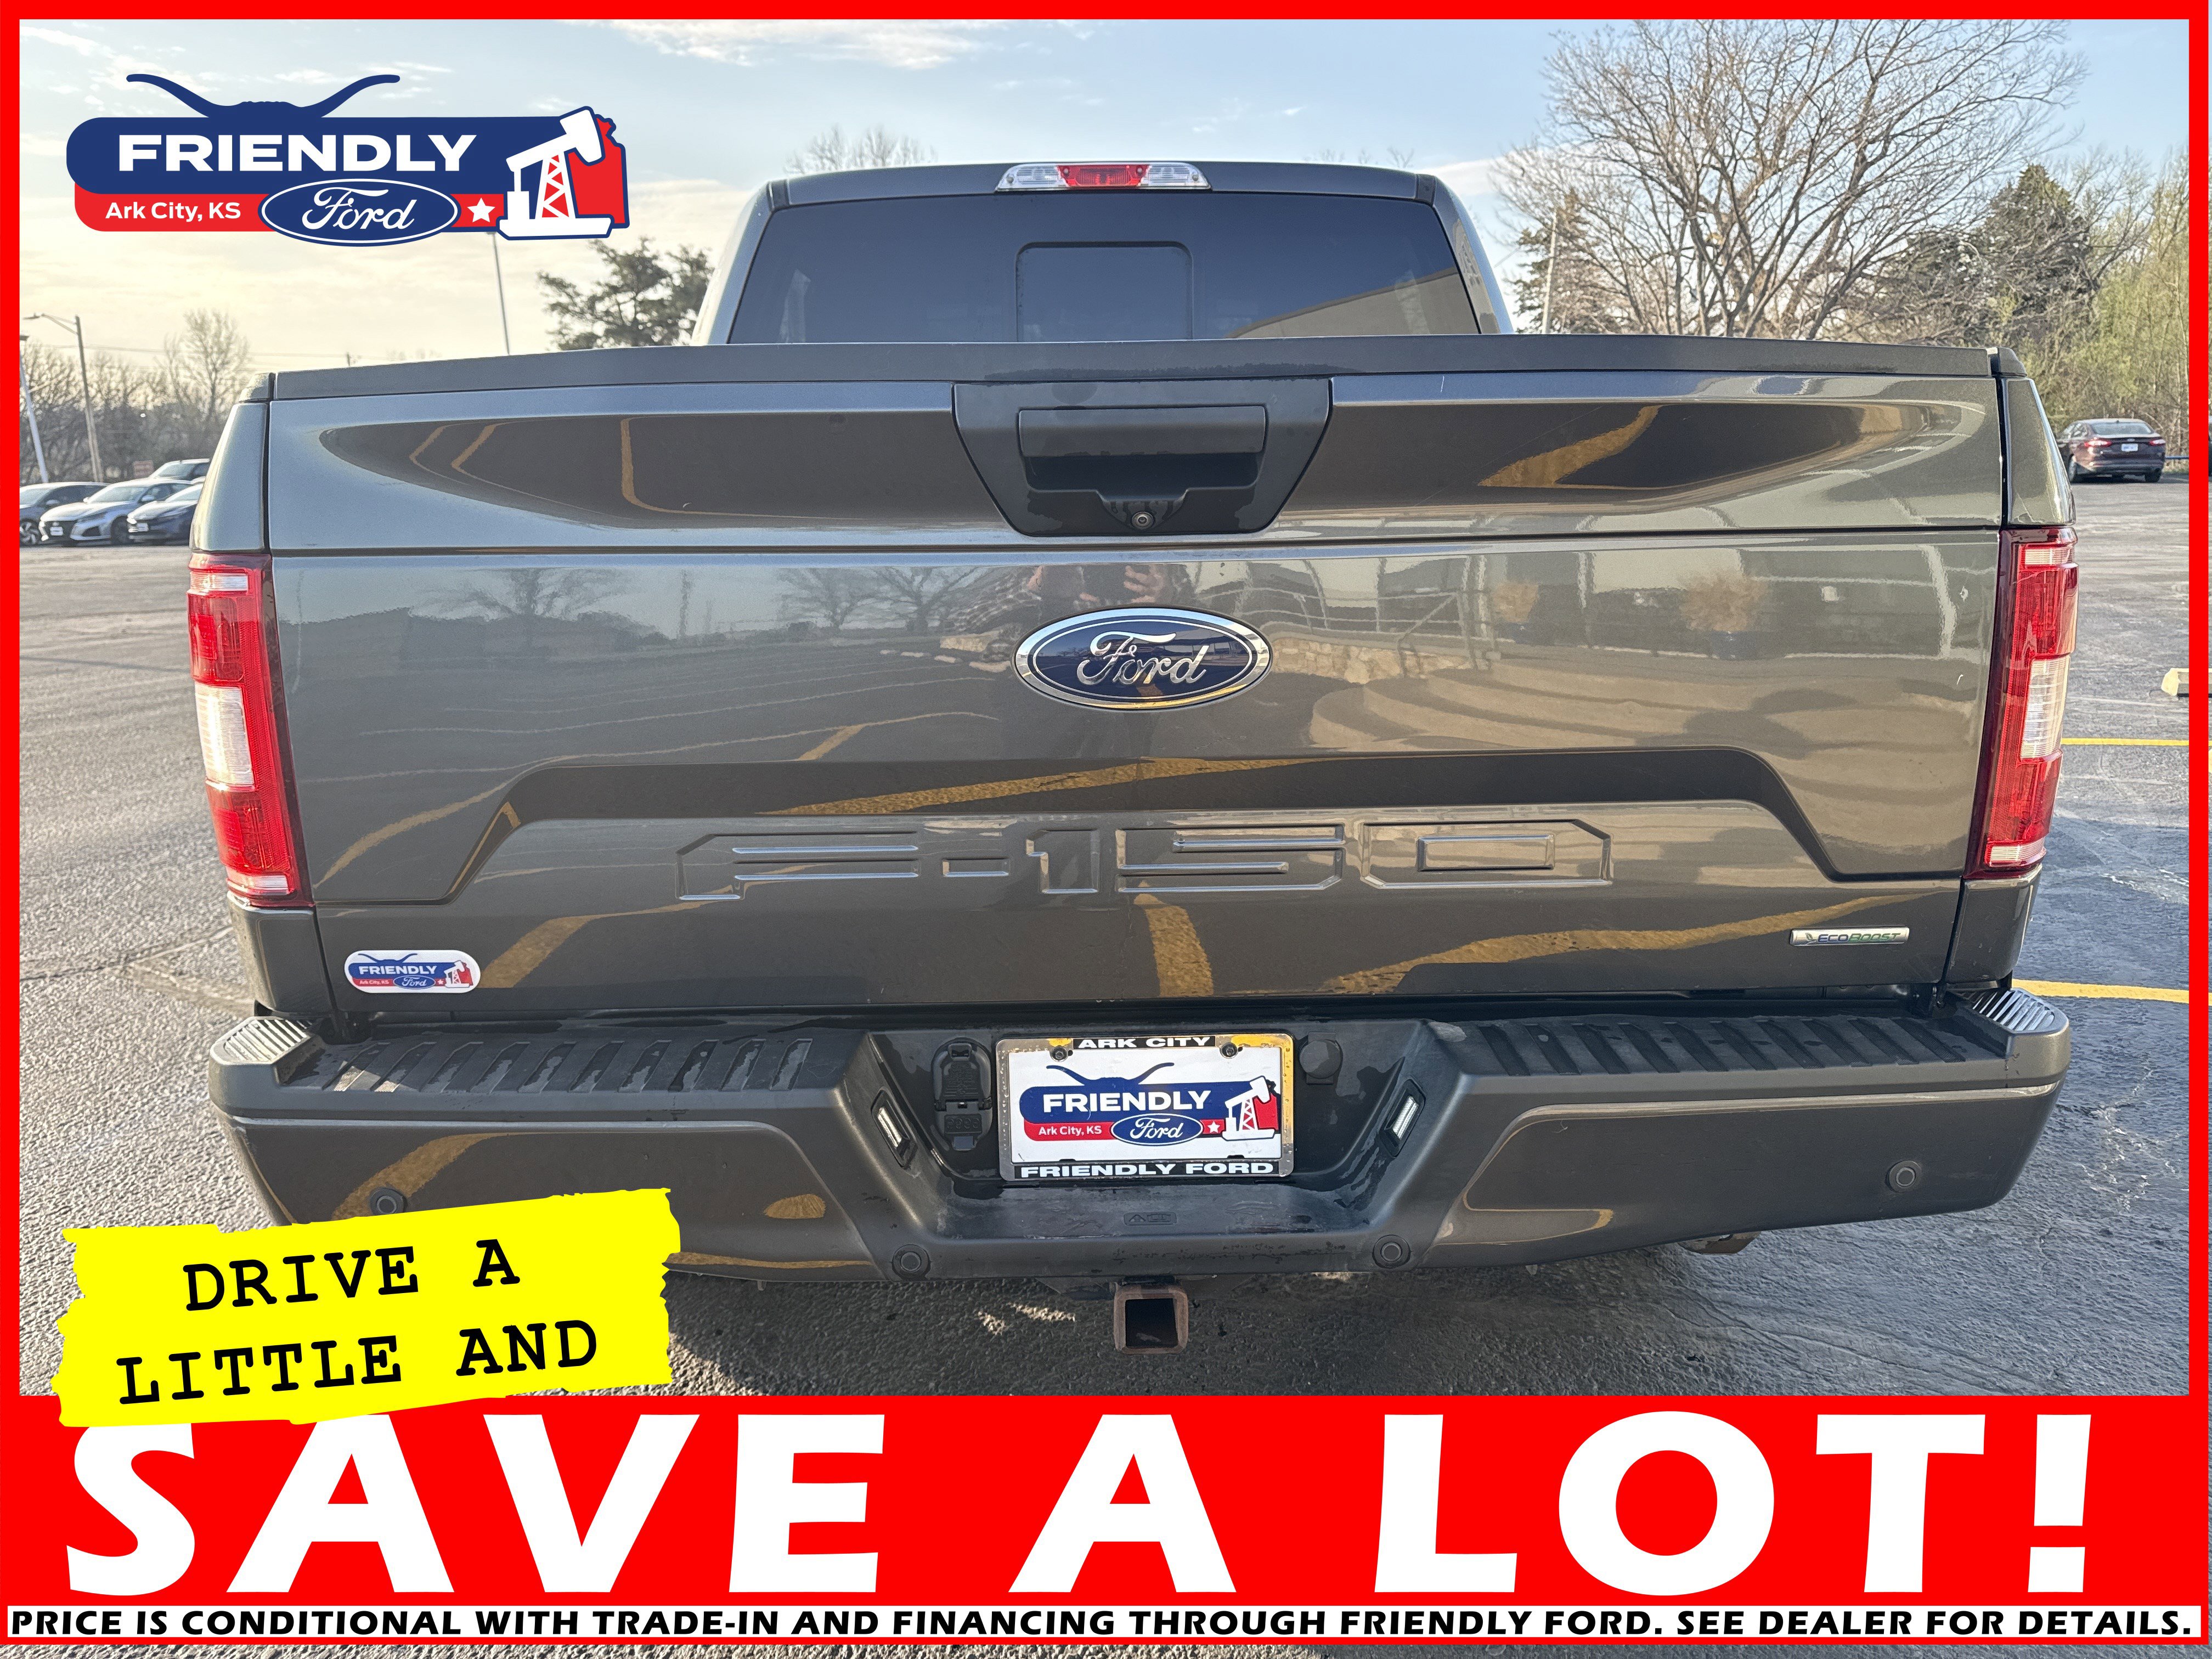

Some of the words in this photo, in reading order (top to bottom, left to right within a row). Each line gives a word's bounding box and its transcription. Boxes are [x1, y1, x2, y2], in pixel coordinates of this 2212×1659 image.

[1077, 631, 1210, 685] Ford
[675, 819, 1613, 901] F-150
[358, 966, 437, 975] FRIENDLY
[402, 977, 426, 986] Ford
[1078, 1039, 1137, 1048] ARK
[1146, 1036, 1210, 1047] CITY
[1043, 1091, 1211, 1113] FRIENDLY
[1038, 1126, 1058, 1136] Ark
[1059, 1125, 1085, 1137] City,
[1086, 1125, 1102, 1135] KS
[1130, 1118, 1183, 1139] Ford
[1020, 1164, 1176, 1178] FRIENDLY
[1185, 1163, 1273, 1176] FORD
